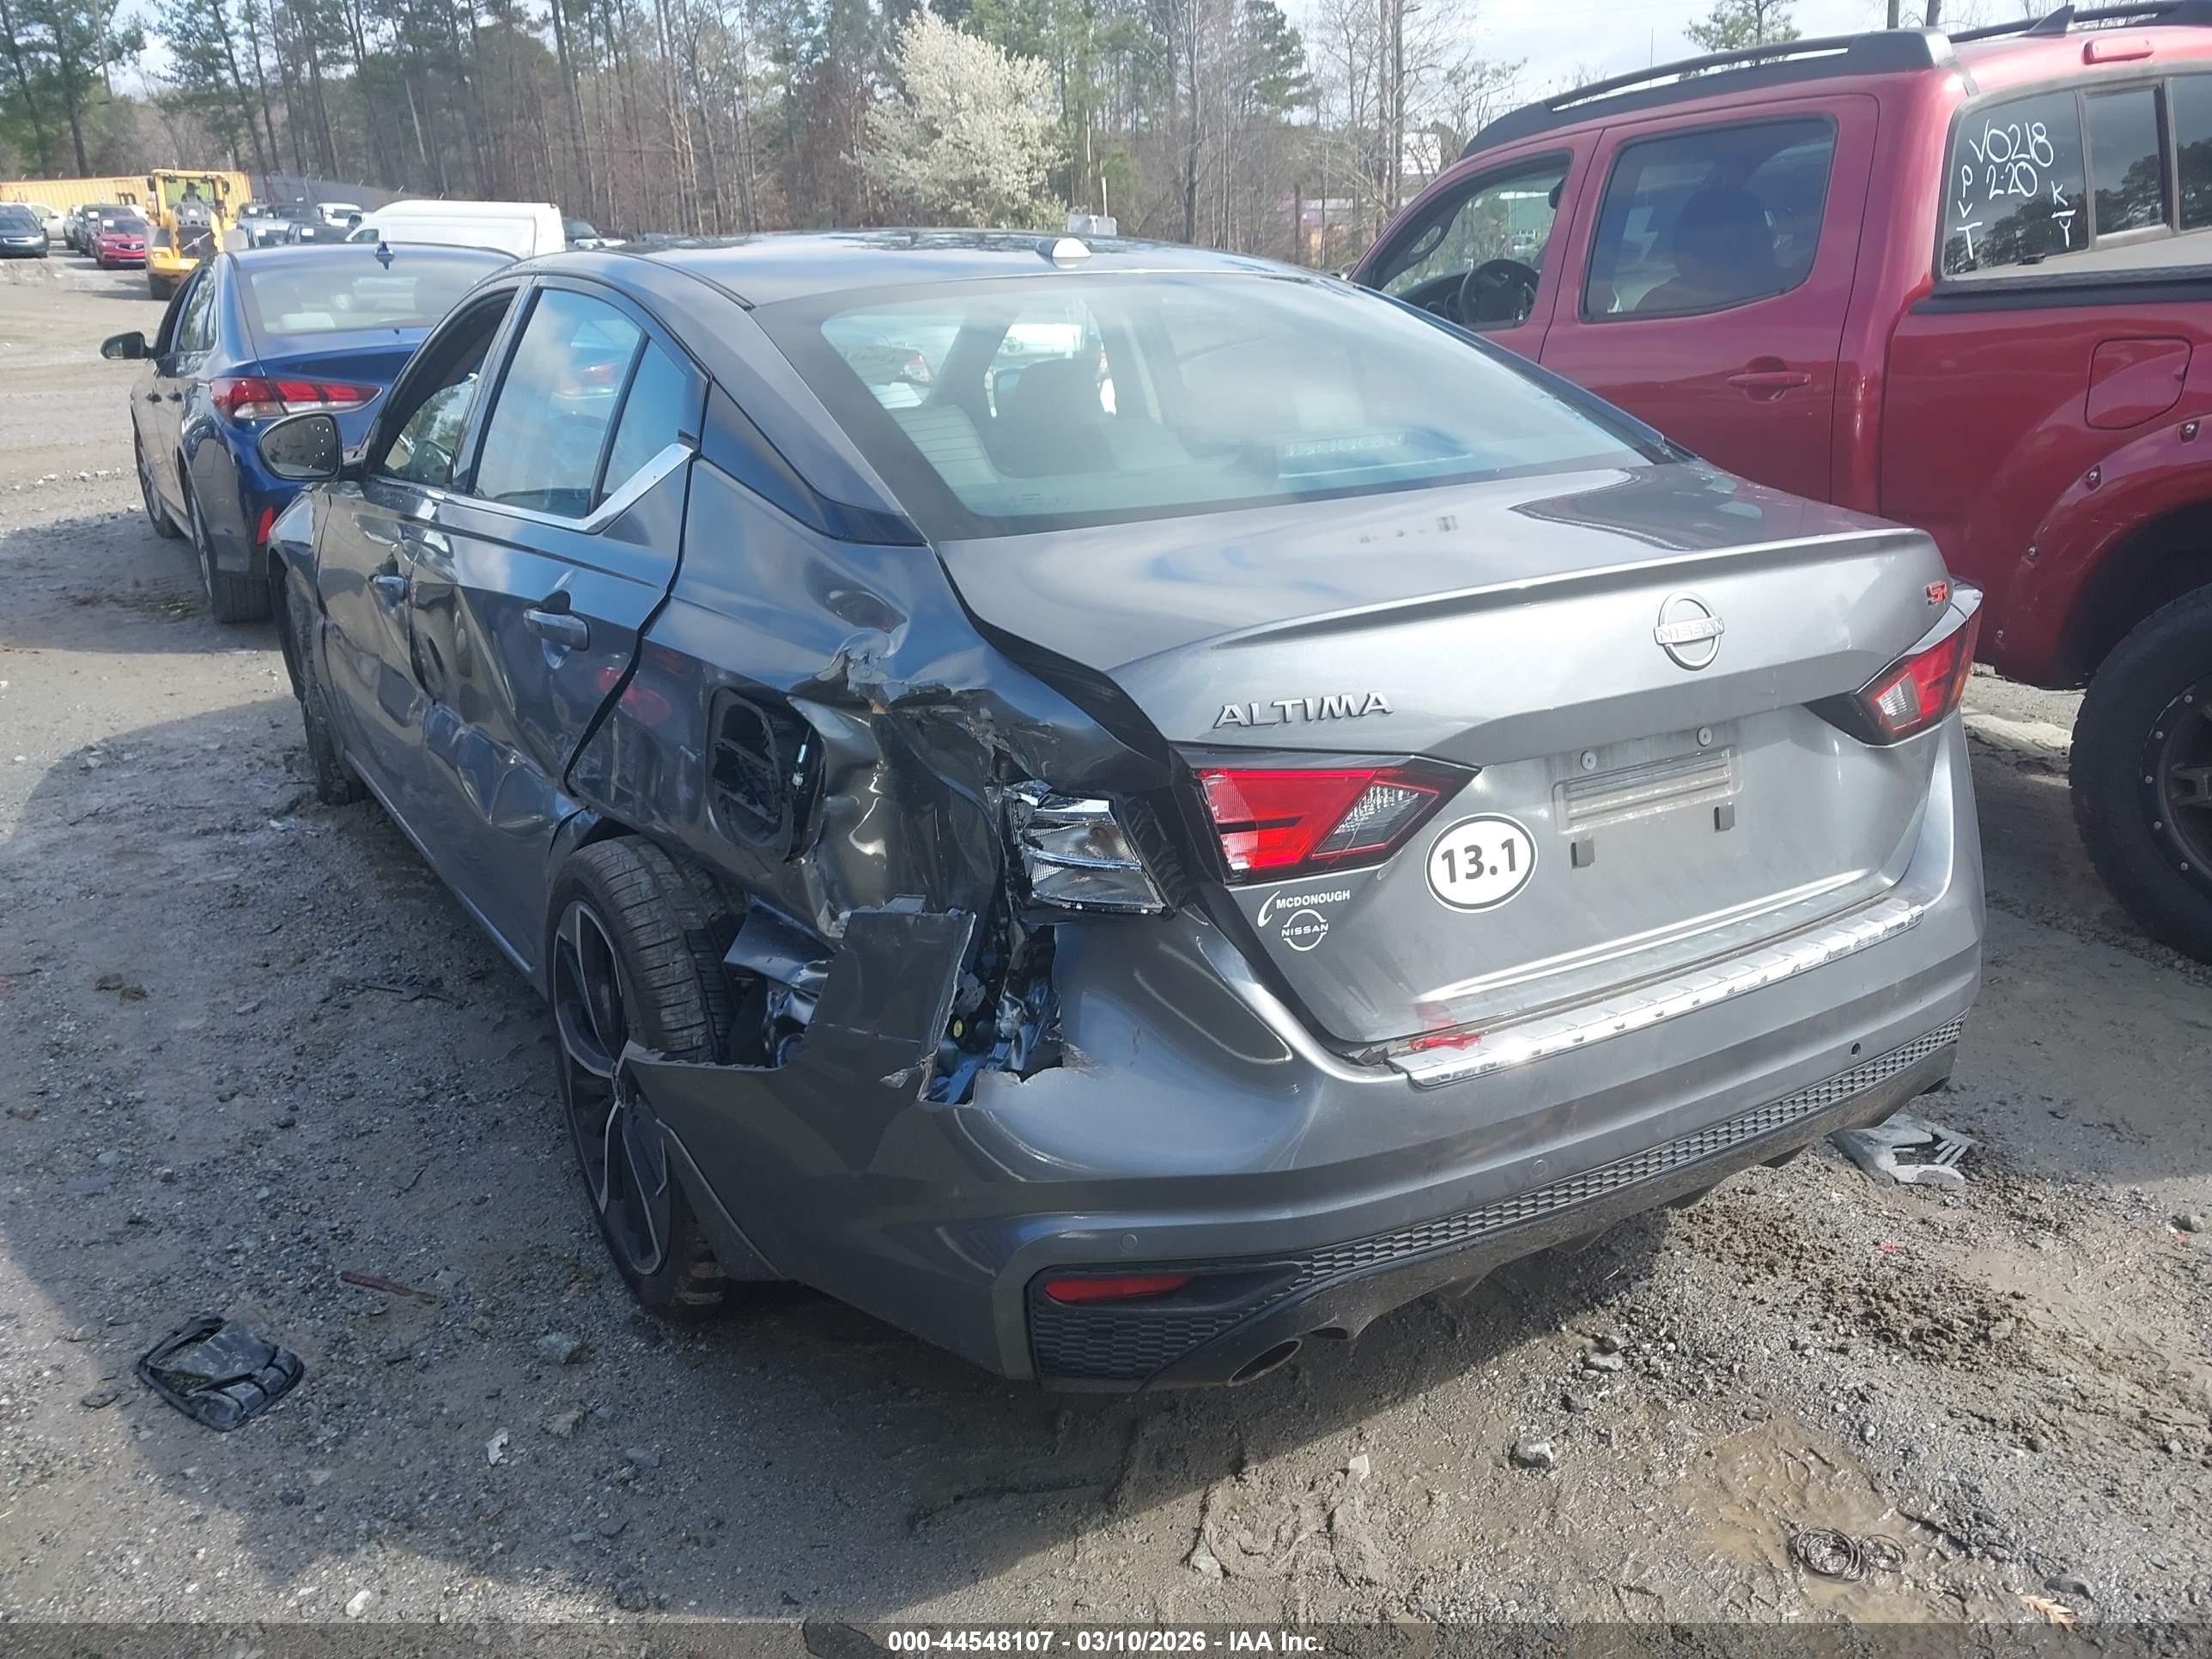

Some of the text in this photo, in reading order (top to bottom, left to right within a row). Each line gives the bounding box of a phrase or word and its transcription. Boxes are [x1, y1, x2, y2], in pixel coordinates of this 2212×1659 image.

[1658, 618, 1723, 641] NISSAN
[1213, 691, 1395, 729] ALTIMA
[1441, 838, 1516, 884] 13.1
[1276, 890, 1350, 909] MCDONOUGH
[1281, 923, 1329, 937] NISSAN
